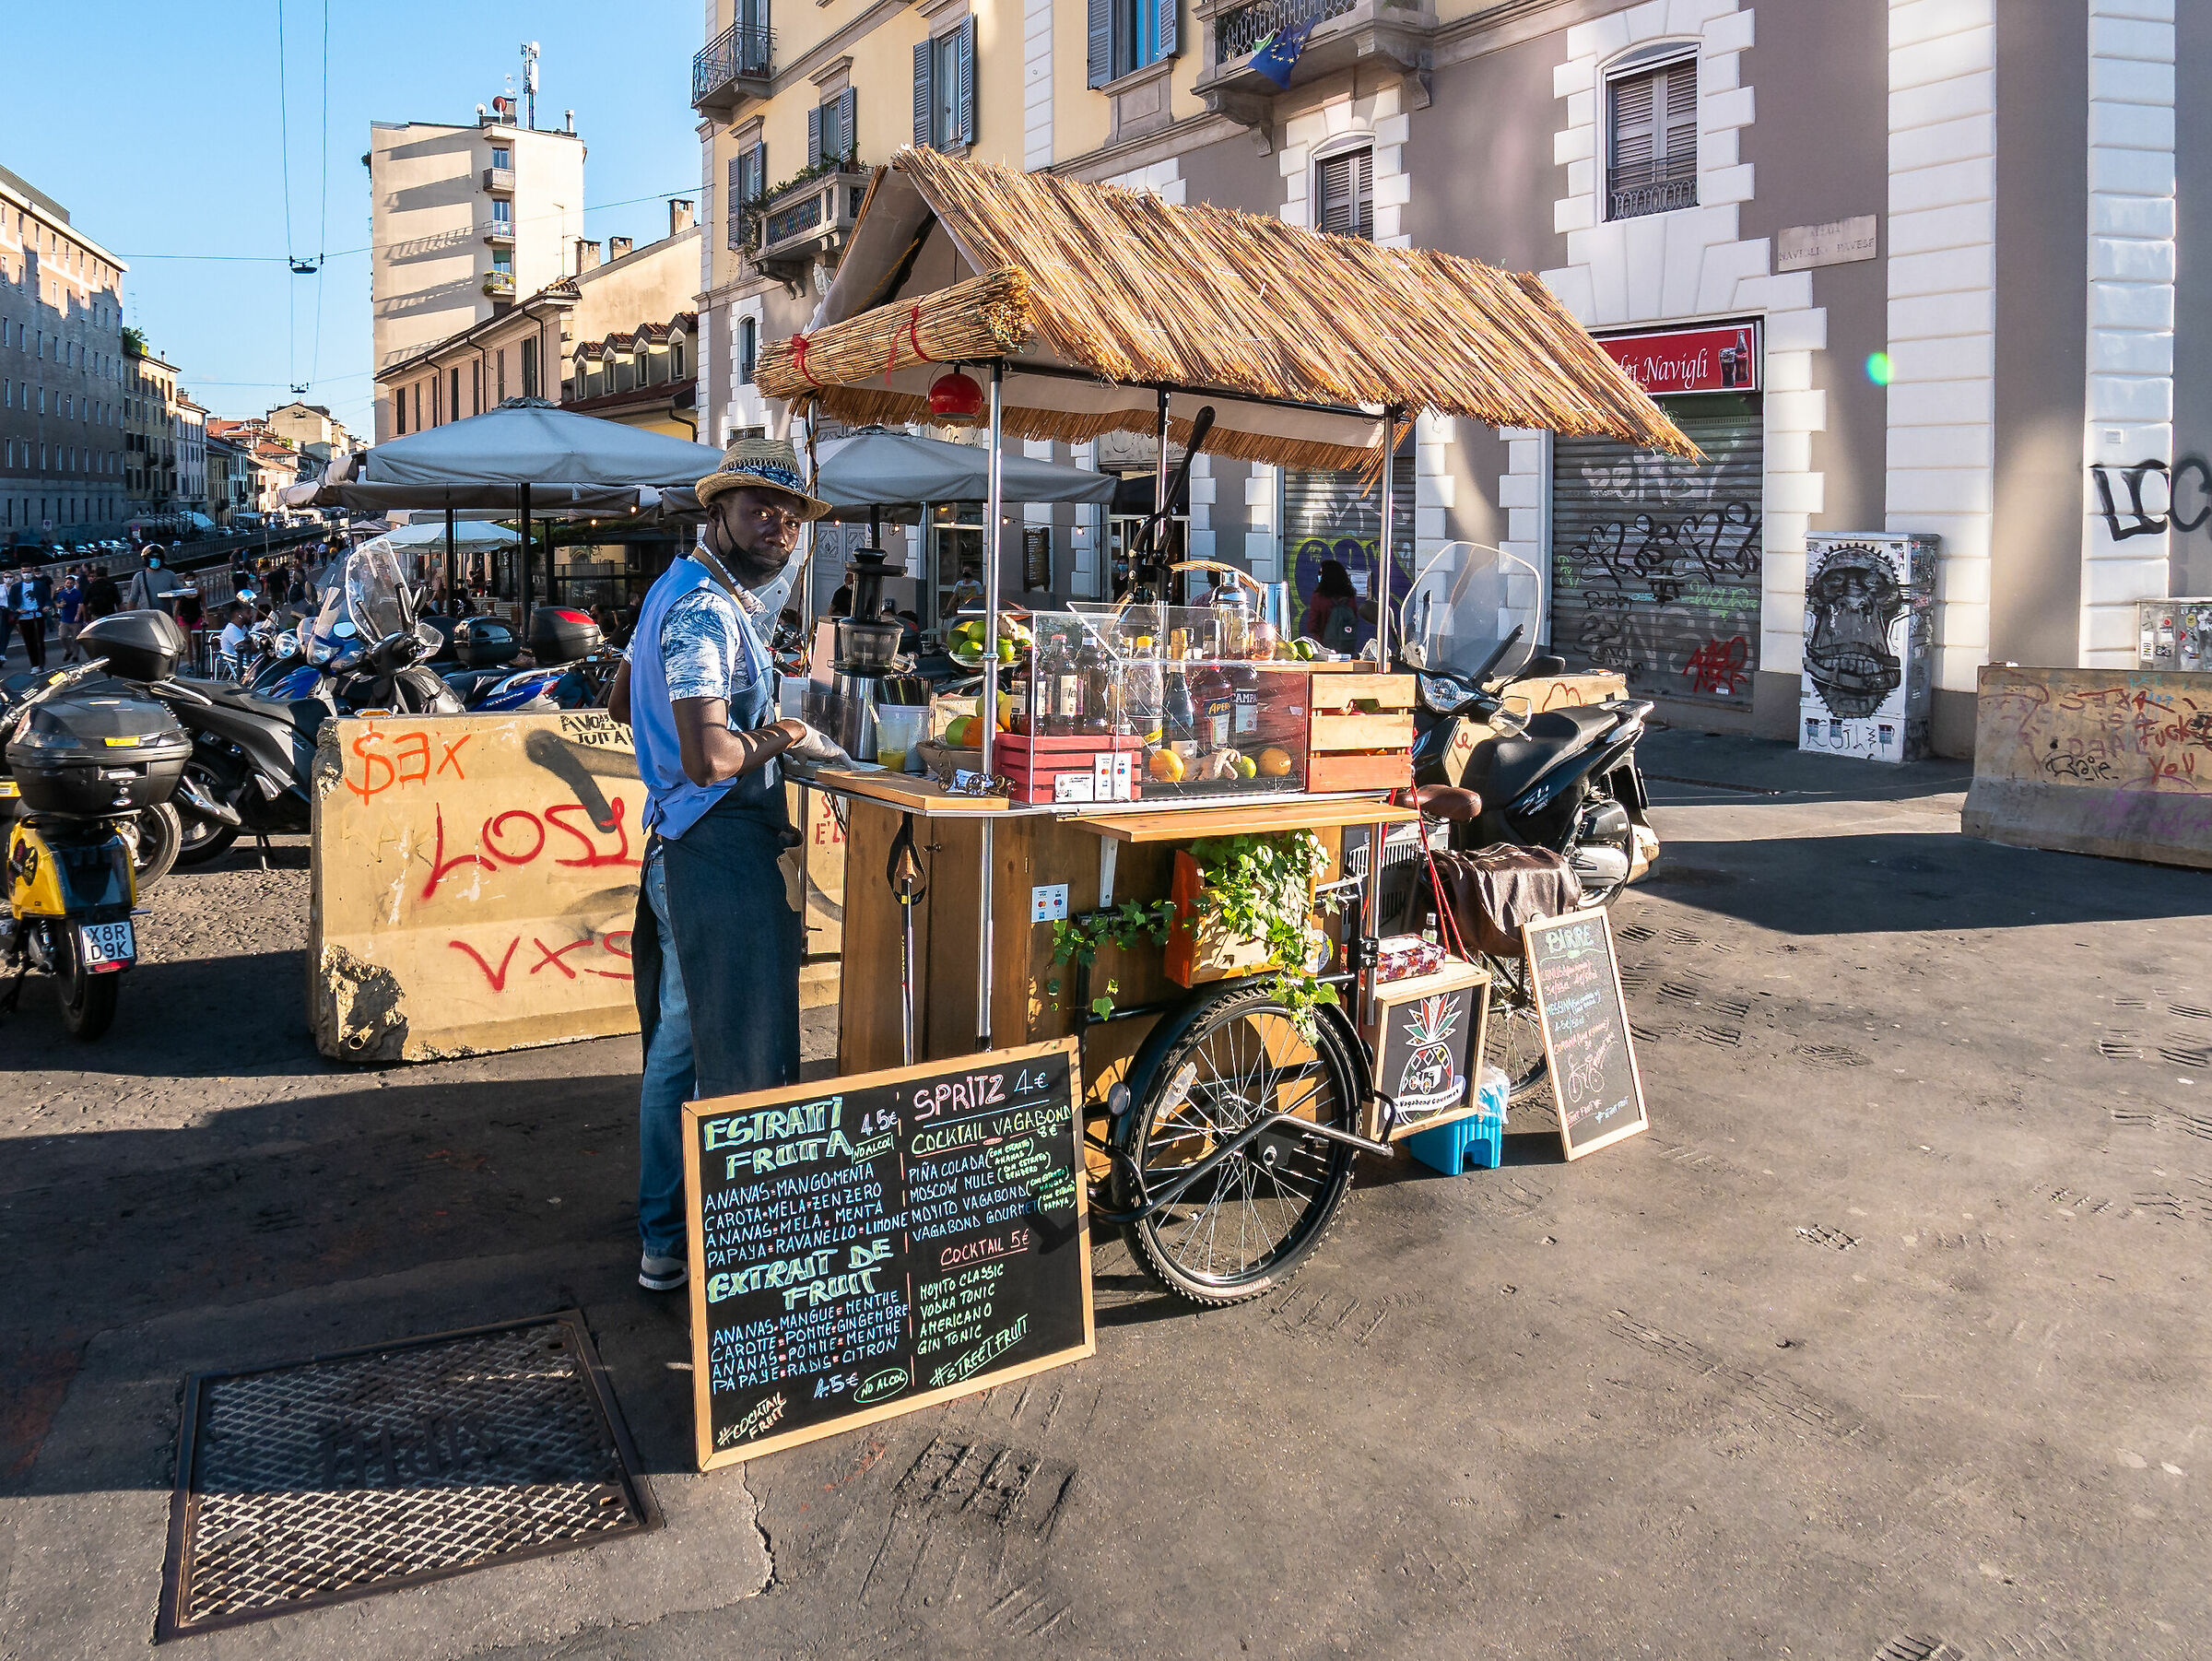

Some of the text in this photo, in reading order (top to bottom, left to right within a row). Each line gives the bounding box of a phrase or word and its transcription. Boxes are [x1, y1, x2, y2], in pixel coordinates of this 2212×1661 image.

[1639, 348, 1709, 390] Navigli
[89, 925, 125, 943] X8R
[91, 941, 128, 960] D9K
[912, 1074, 1006, 1121] SPRITZ
[1399, 1089, 1460, 1108] Vagabond Gourmet
[704, 1096, 843, 1151] ESTRATTI
[911, 1104, 1072, 1155] COCKTAIL VAGABOND
[725, 1129, 853, 1180] FRUTTA
[909, 1160, 937, 1184] PIÑA
[941, 1154, 985, 1177] COLADA
[704, 1162, 875, 1213] ANANAS MANGO MENTA
[704, 1183, 882, 1231] CAROTA MELA ZENZERO
[910, 1177, 958, 1203] MOSCOW
[964, 1172, 995, 1191] MULE
[962, 1184, 1026, 1213] VAGABOND
[1043, 1197, 1069, 1211] PAPAYA
[705, 1199, 883, 1248] ANANAS MELA MENTA
[707, 1212, 909, 1269] PAPAYA RAVANELLO LIMONE
[912, 1214, 981, 1242] VAGABOND
[985, 1198, 1039, 1224] GOURMET
[940, 1228, 1030, 1266] COCKTAIL 5€
[707, 1238, 894, 1303] EXTRAIT DE
[782, 1266, 882, 1311] FRUIT
[959, 1263, 1004, 1286] CLASSIC
[713, 1290, 898, 1347] ANANAS MANGUE MENTHE
[919, 1302, 993, 1338] AMERICANO
[920, 1282, 995, 1320] VODKA TONIC
[712, 1303, 909, 1363] CAROTTE POMME GINGEMBRE
[712, 1320, 900, 1378] ANANAS POMME MENTHE
[917, 1324, 982, 1356] GIN TONIC
[929, 1313, 1030, 1387] #STREET FRUIT
[787, 1356, 831, 1378] RADIS
[842, 1337, 898, 1364] CITRON
[861, 1381, 874, 1398] NO
[877, 1370, 905, 1393] ALCOL
[749, 1404, 783, 1440] FRUIT
